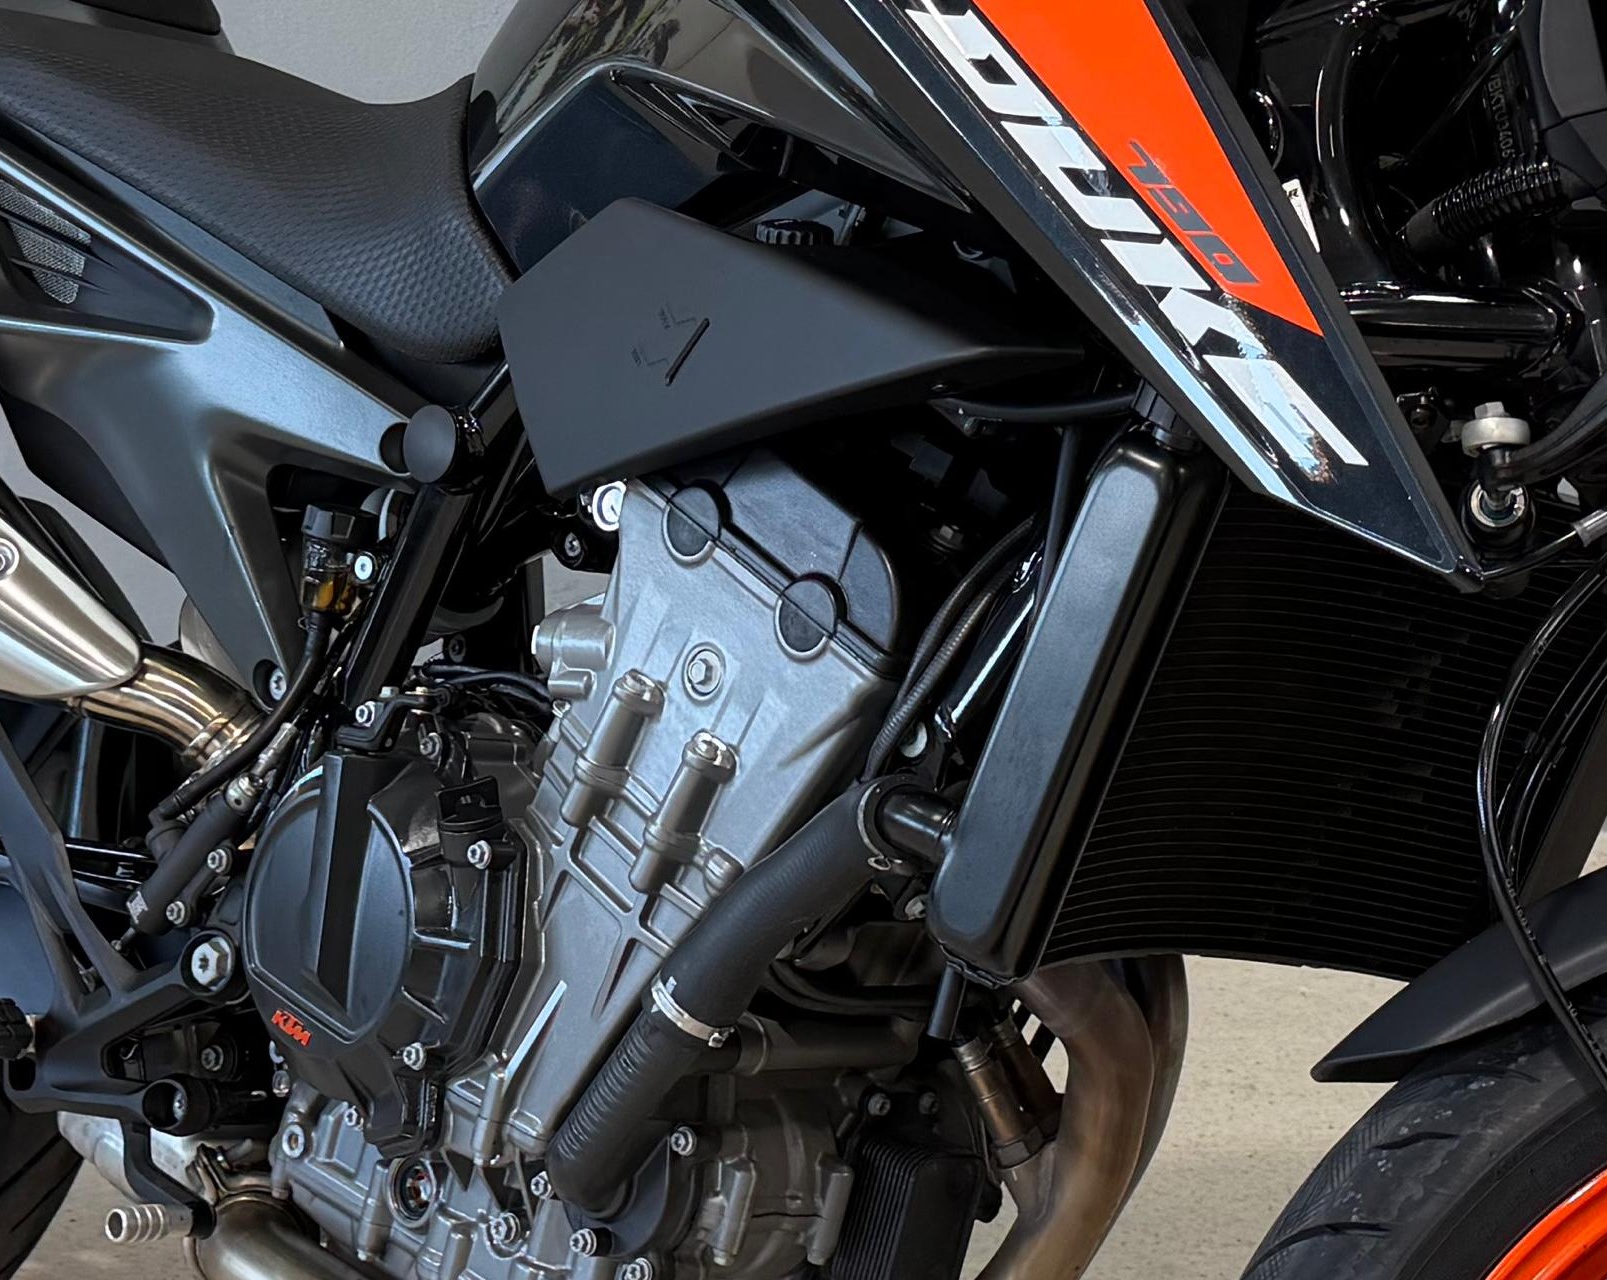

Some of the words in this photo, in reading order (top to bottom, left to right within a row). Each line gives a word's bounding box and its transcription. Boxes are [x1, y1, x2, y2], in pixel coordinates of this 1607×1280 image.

[905, 8, 1370, 476] DUKE
[1126, 138, 1262, 285] 790
[270, 1008, 313, 1047] KTM
